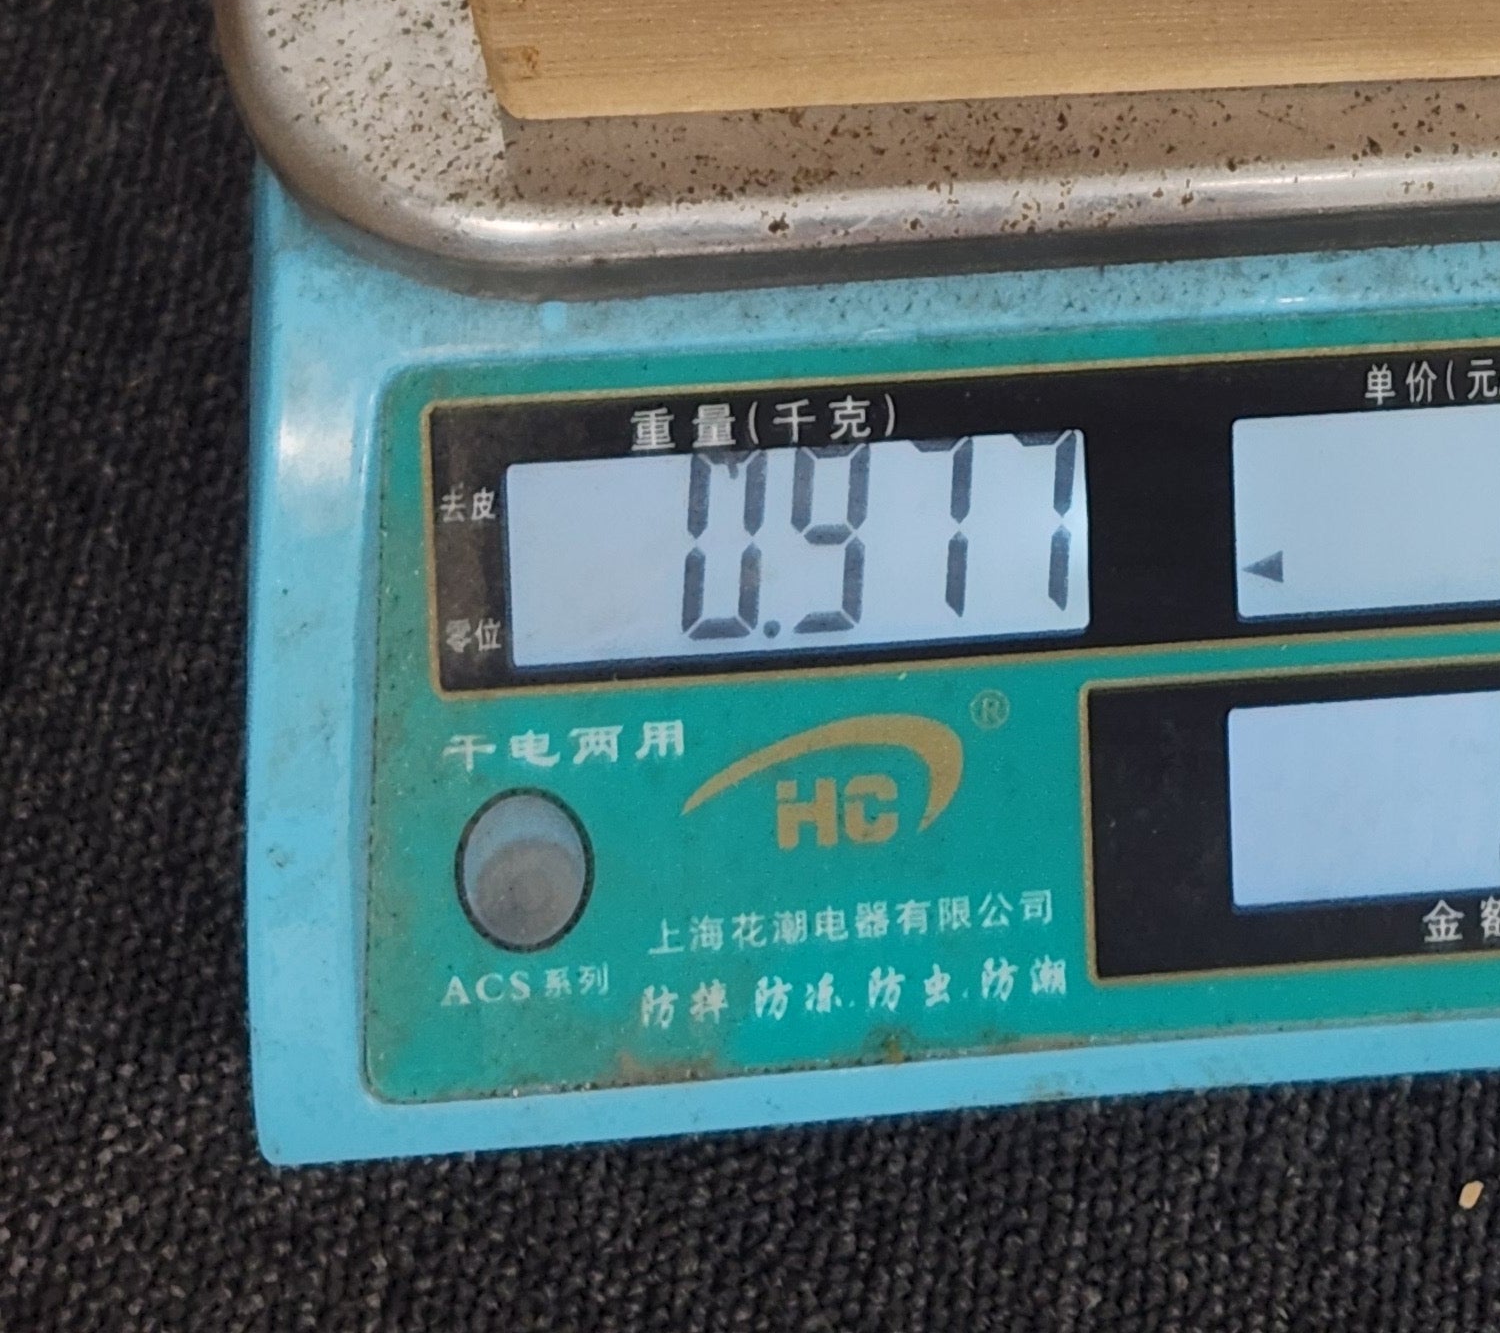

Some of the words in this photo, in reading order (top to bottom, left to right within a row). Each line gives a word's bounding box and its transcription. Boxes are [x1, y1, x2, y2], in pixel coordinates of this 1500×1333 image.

[630, 394, 897, 451] 重量(千克)
[440, 484, 496, 522] 去皮
[680, 429, 1082, 641] 0.977
[443, 719, 686, 773] 干电两用
[775, 773, 901, 850] HC
[647, 889, 1055, 956] 上海花潮电器有限公司
[440, 967, 533, 1007] ACS
[542, 961, 611, 997] 系列
